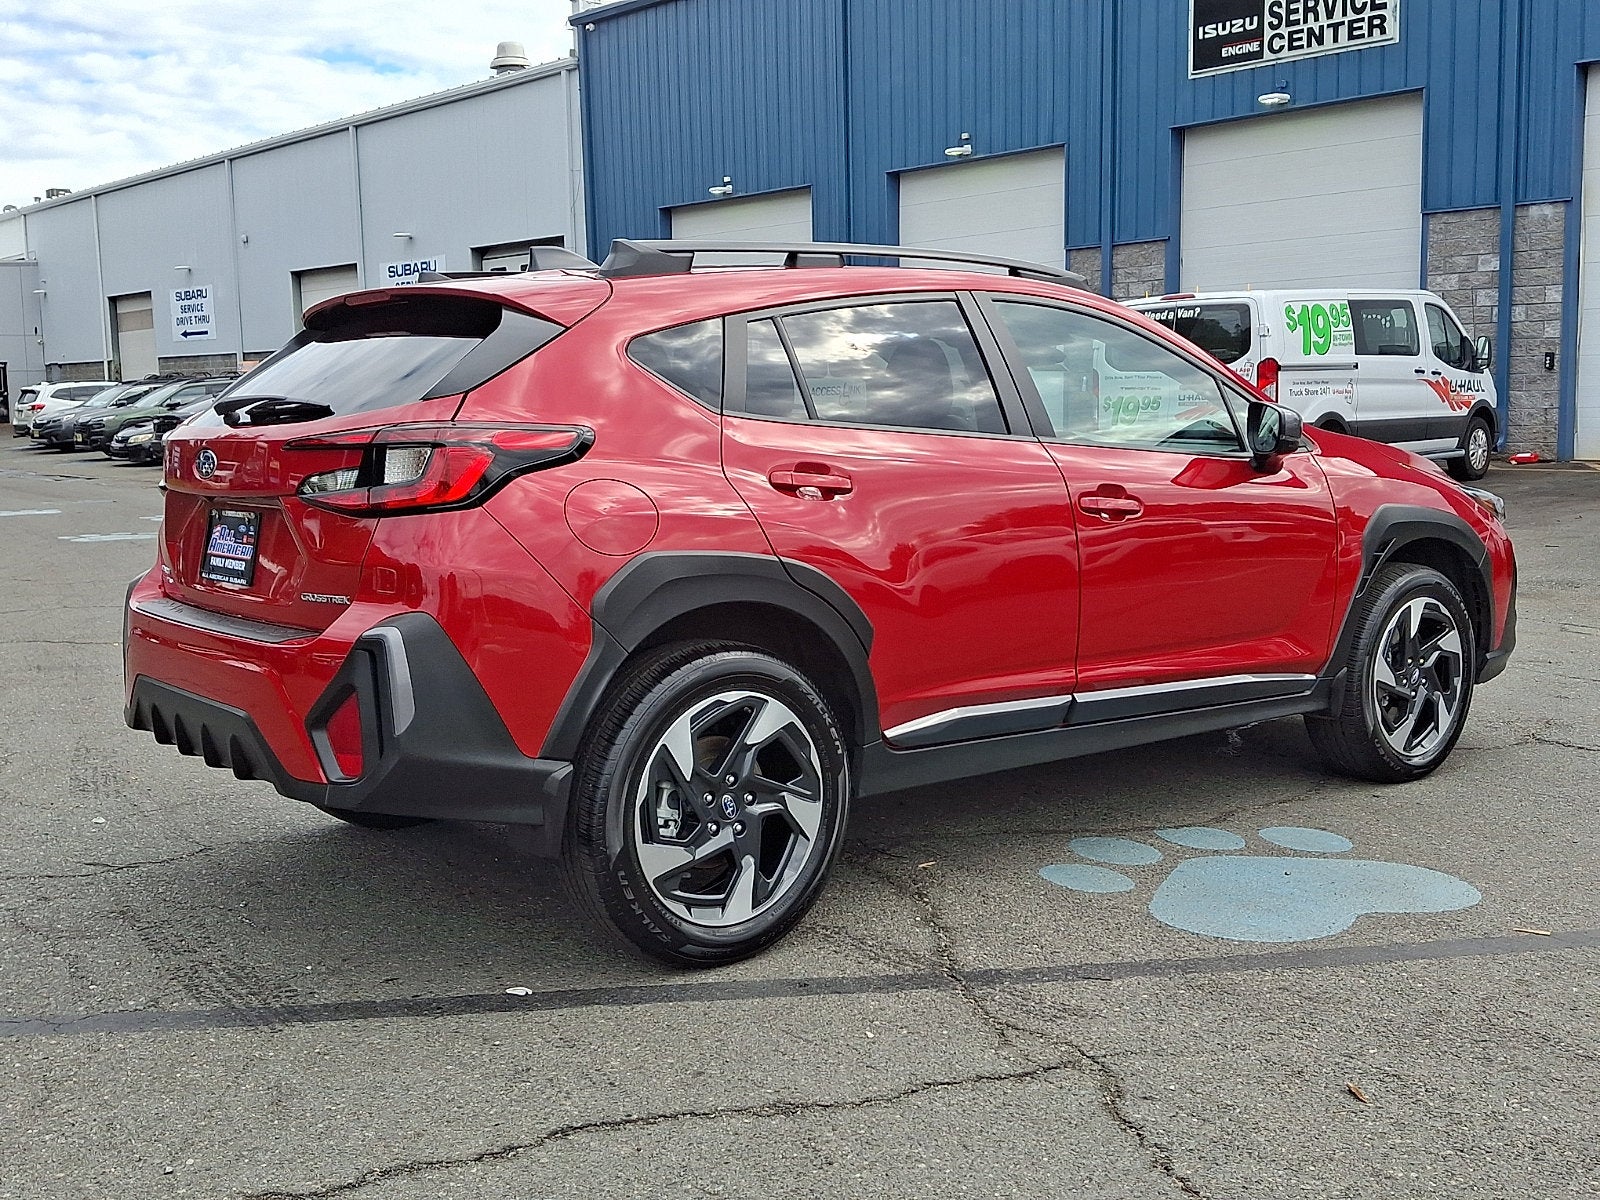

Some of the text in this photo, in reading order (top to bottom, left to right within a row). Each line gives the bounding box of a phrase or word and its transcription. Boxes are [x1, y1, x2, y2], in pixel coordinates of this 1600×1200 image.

[1198, 15, 1258, 40] ISUZU
[1267, 13, 1388, 55] CENTER
[1221, 41, 1261, 58] ENGINE
[387, 259, 437, 279] SUBARU
[174, 287, 208, 302] SUBARU
[180, 302, 204, 314] SERVICE
[1168, 311, 1174, 320] a
[1177, 306, 1200, 319] Van?
[175, 314, 210, 326] DRIVE THRU
[1289, 388, 1303, 397] Truck
[1304, 387, 1319, 396] Share
[1450, 379, 1486, 393] U-HAUL
[300, 592, 351, 605] CROSSTREK
